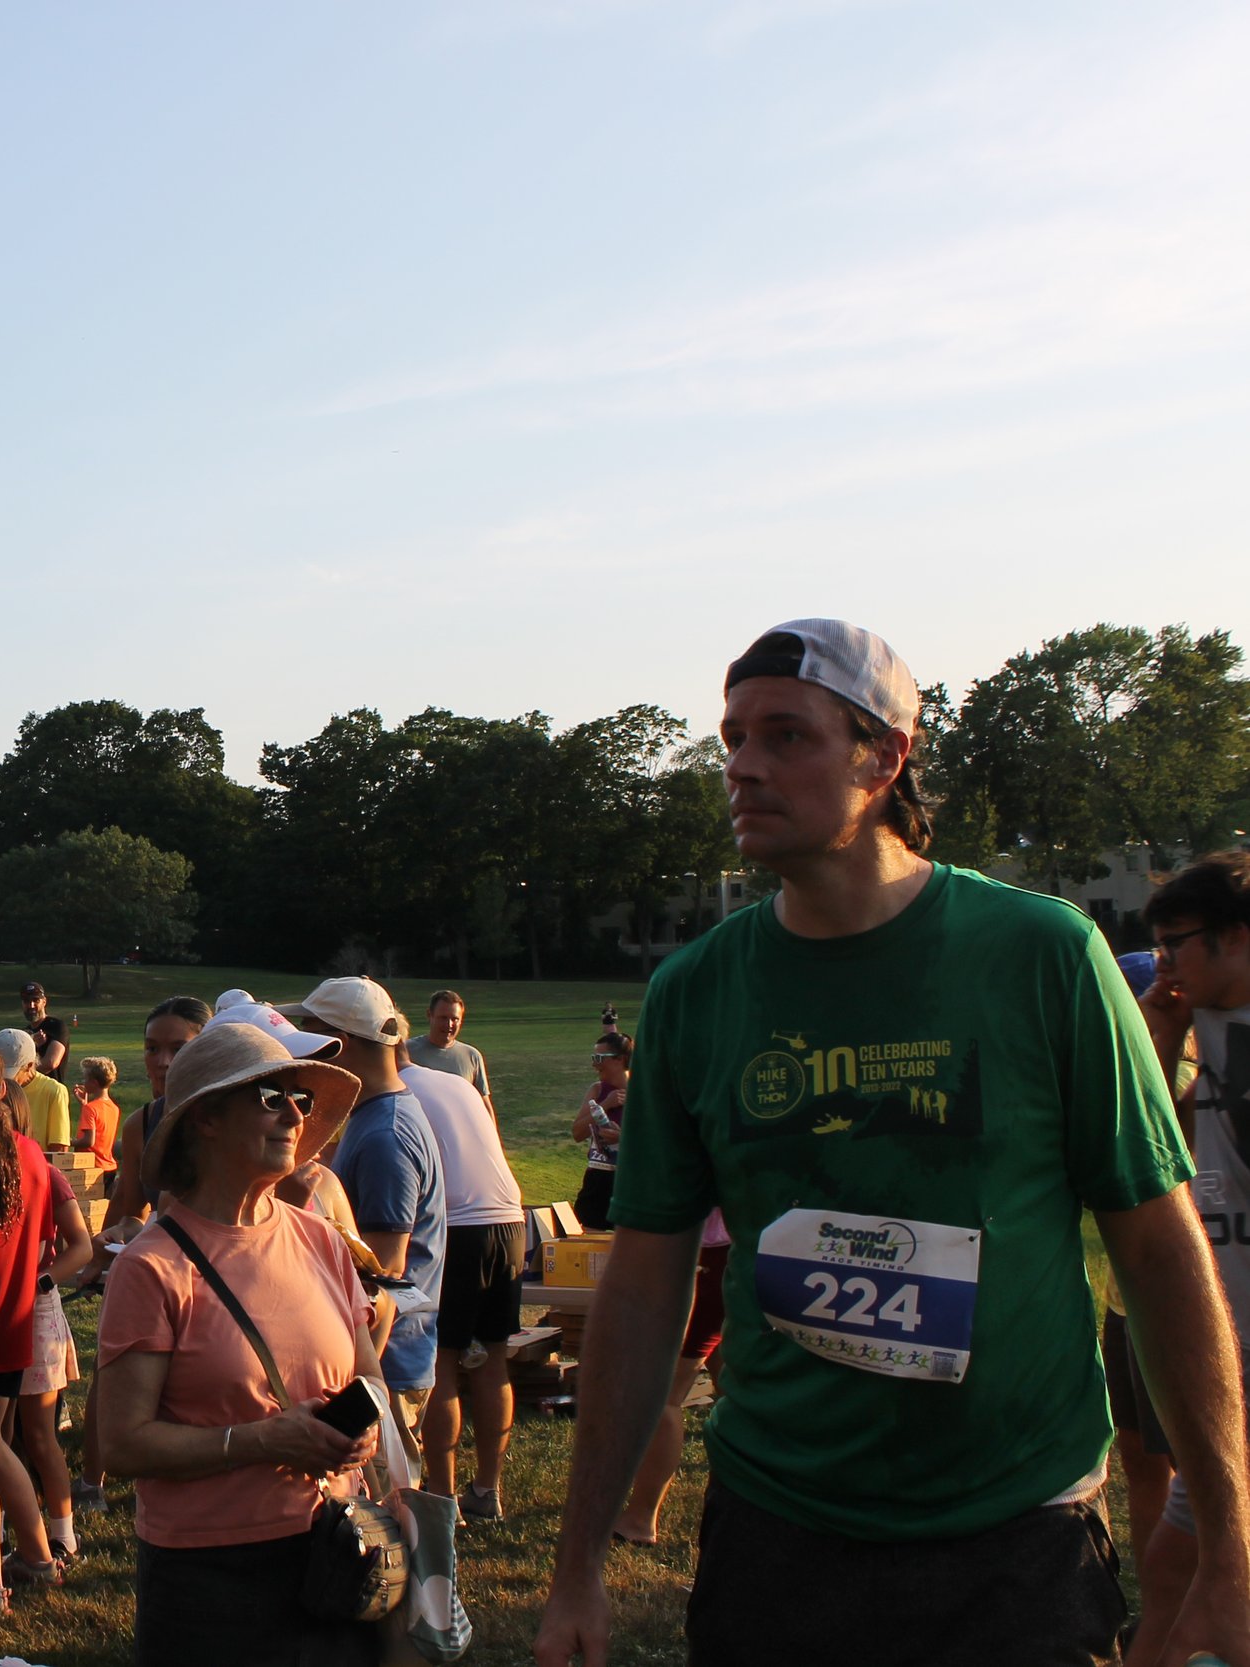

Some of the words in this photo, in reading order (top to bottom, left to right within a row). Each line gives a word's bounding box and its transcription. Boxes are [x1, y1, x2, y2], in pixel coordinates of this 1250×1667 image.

[859, 1040, 950, 1062] CELEBRATING
[757, 1068, 787, 1083] HIKE
[804, 1046, 856, 1096] 10
[861, 1063, 886, 1081] TEN
[890, 1060, 936, 1078] YEARS
[757, 1091, 787, 1105] THON
[819, 1222, 890, 1244] Second
[850, 1241, 899, 1262] Wind
[821, 1255, 854, 1265] RACE
[859, 1261, 905, 1272] TIMING
[801, 1271, 922, 1333] 224
